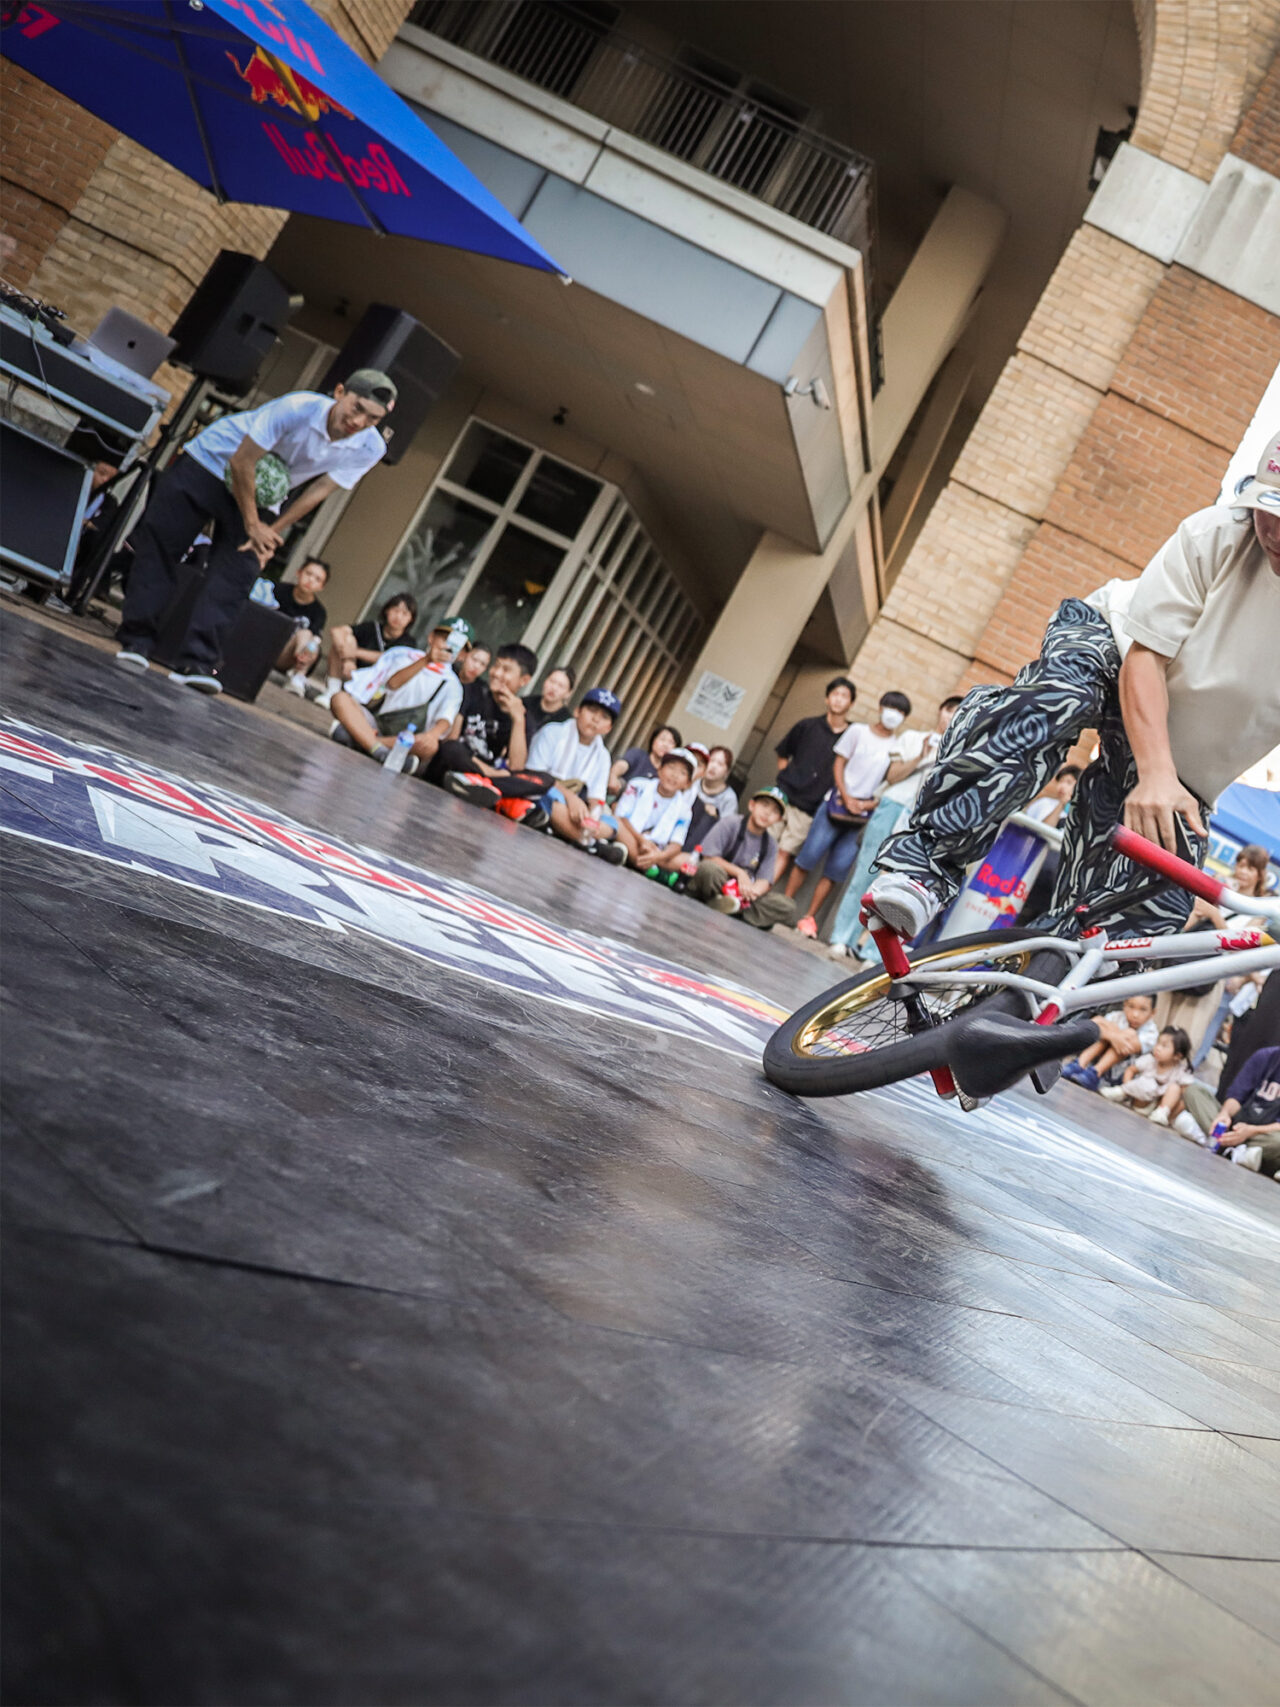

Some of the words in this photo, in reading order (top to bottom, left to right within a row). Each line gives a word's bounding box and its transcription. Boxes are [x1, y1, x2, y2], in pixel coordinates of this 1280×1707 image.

[0, 730, 255, 836] ed
[224, 804, 614, 966] Bull
[0, 755, 769, 1054] REET
[977, 863, 1018, 895] Red
